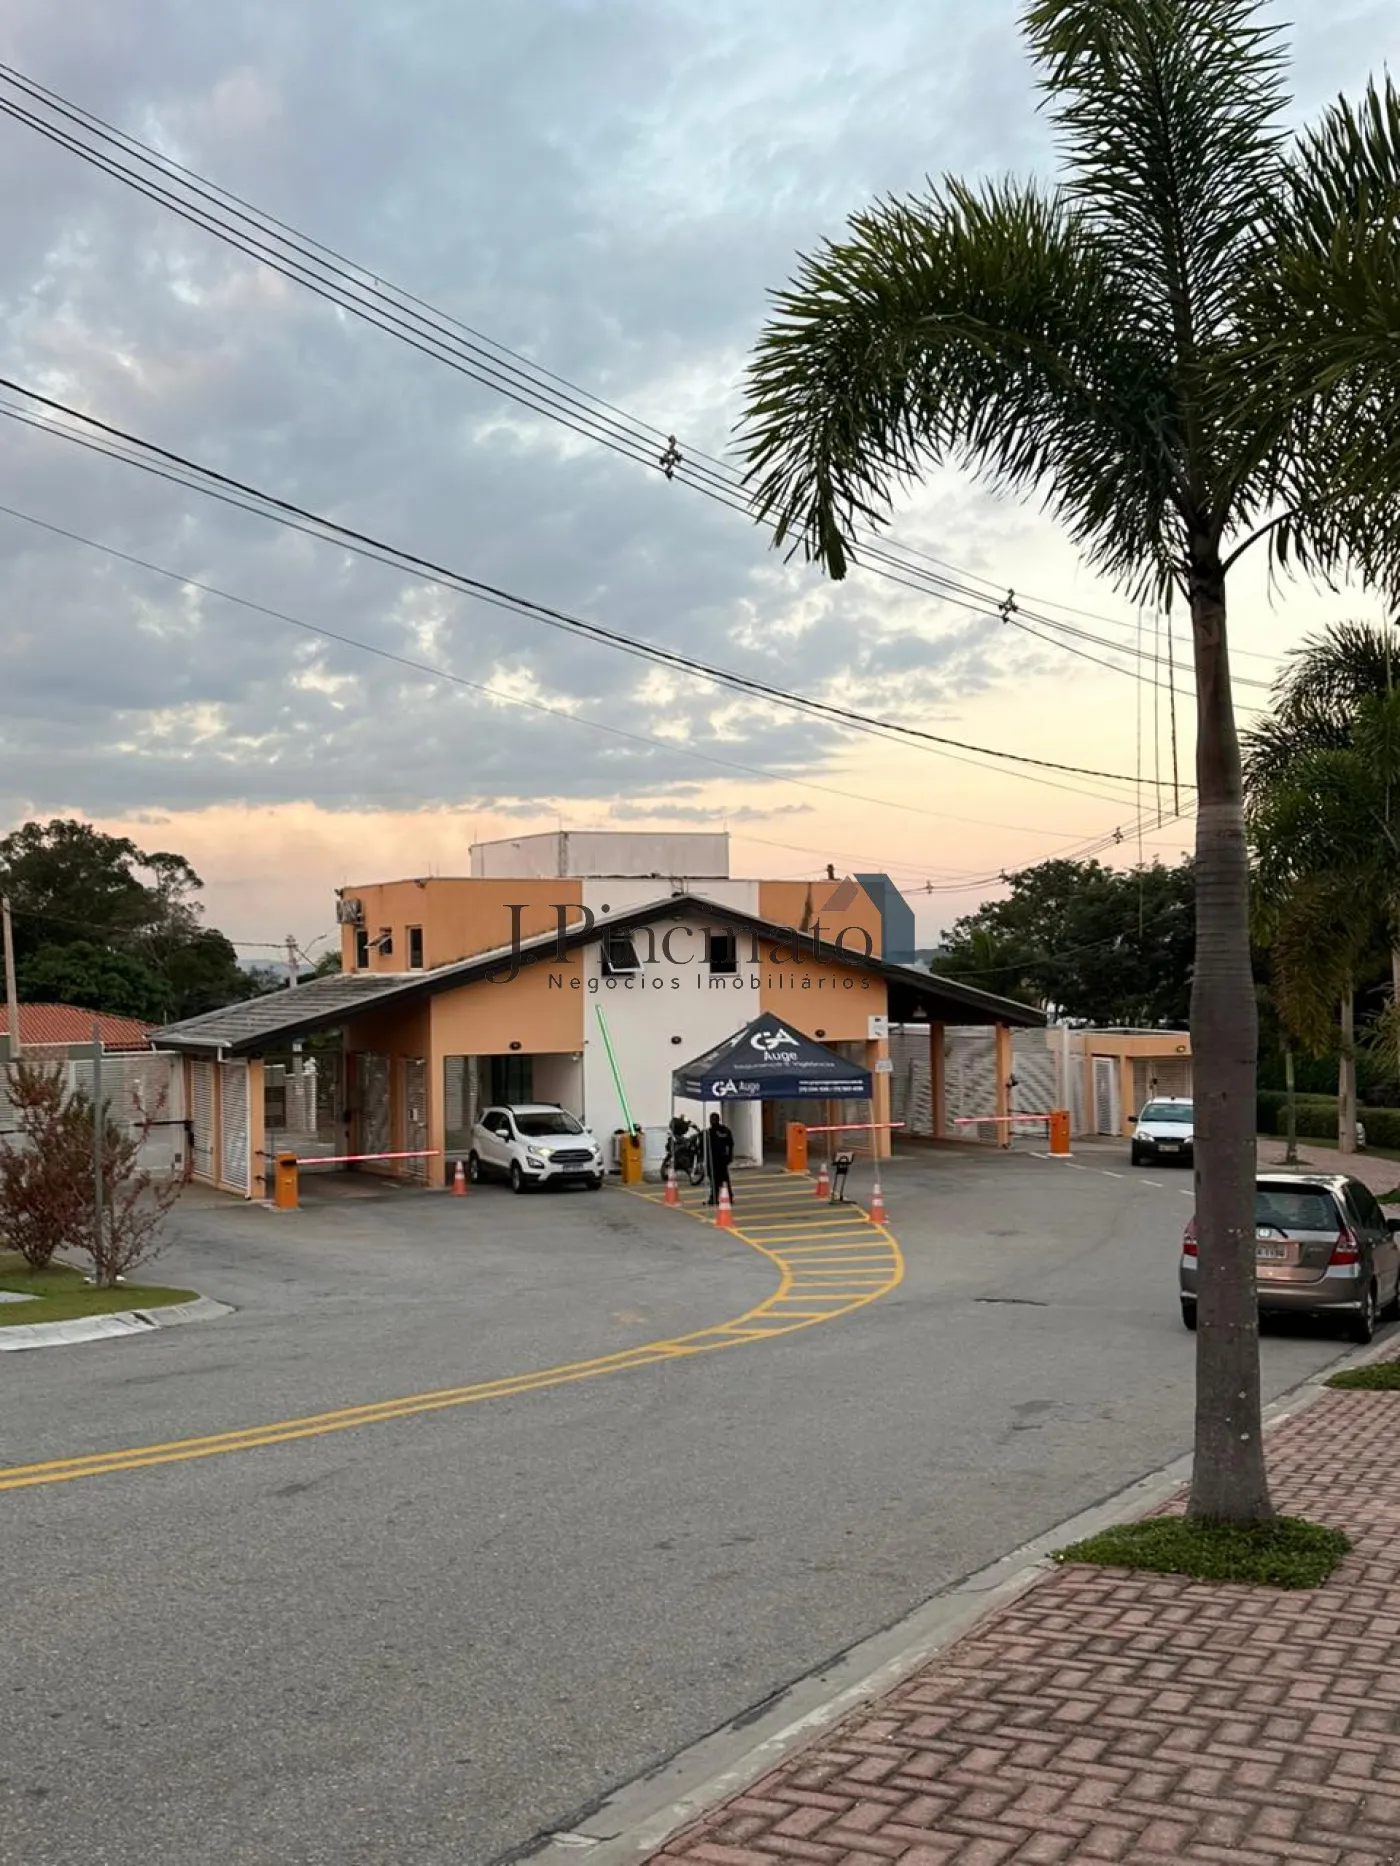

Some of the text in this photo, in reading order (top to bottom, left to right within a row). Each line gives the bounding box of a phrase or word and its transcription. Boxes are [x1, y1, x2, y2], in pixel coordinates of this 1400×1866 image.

[750, 1028, 800, 1050] GA
[763, 1050, 798, 1062] Auge
[712, 1078, 738, 1096] GA
